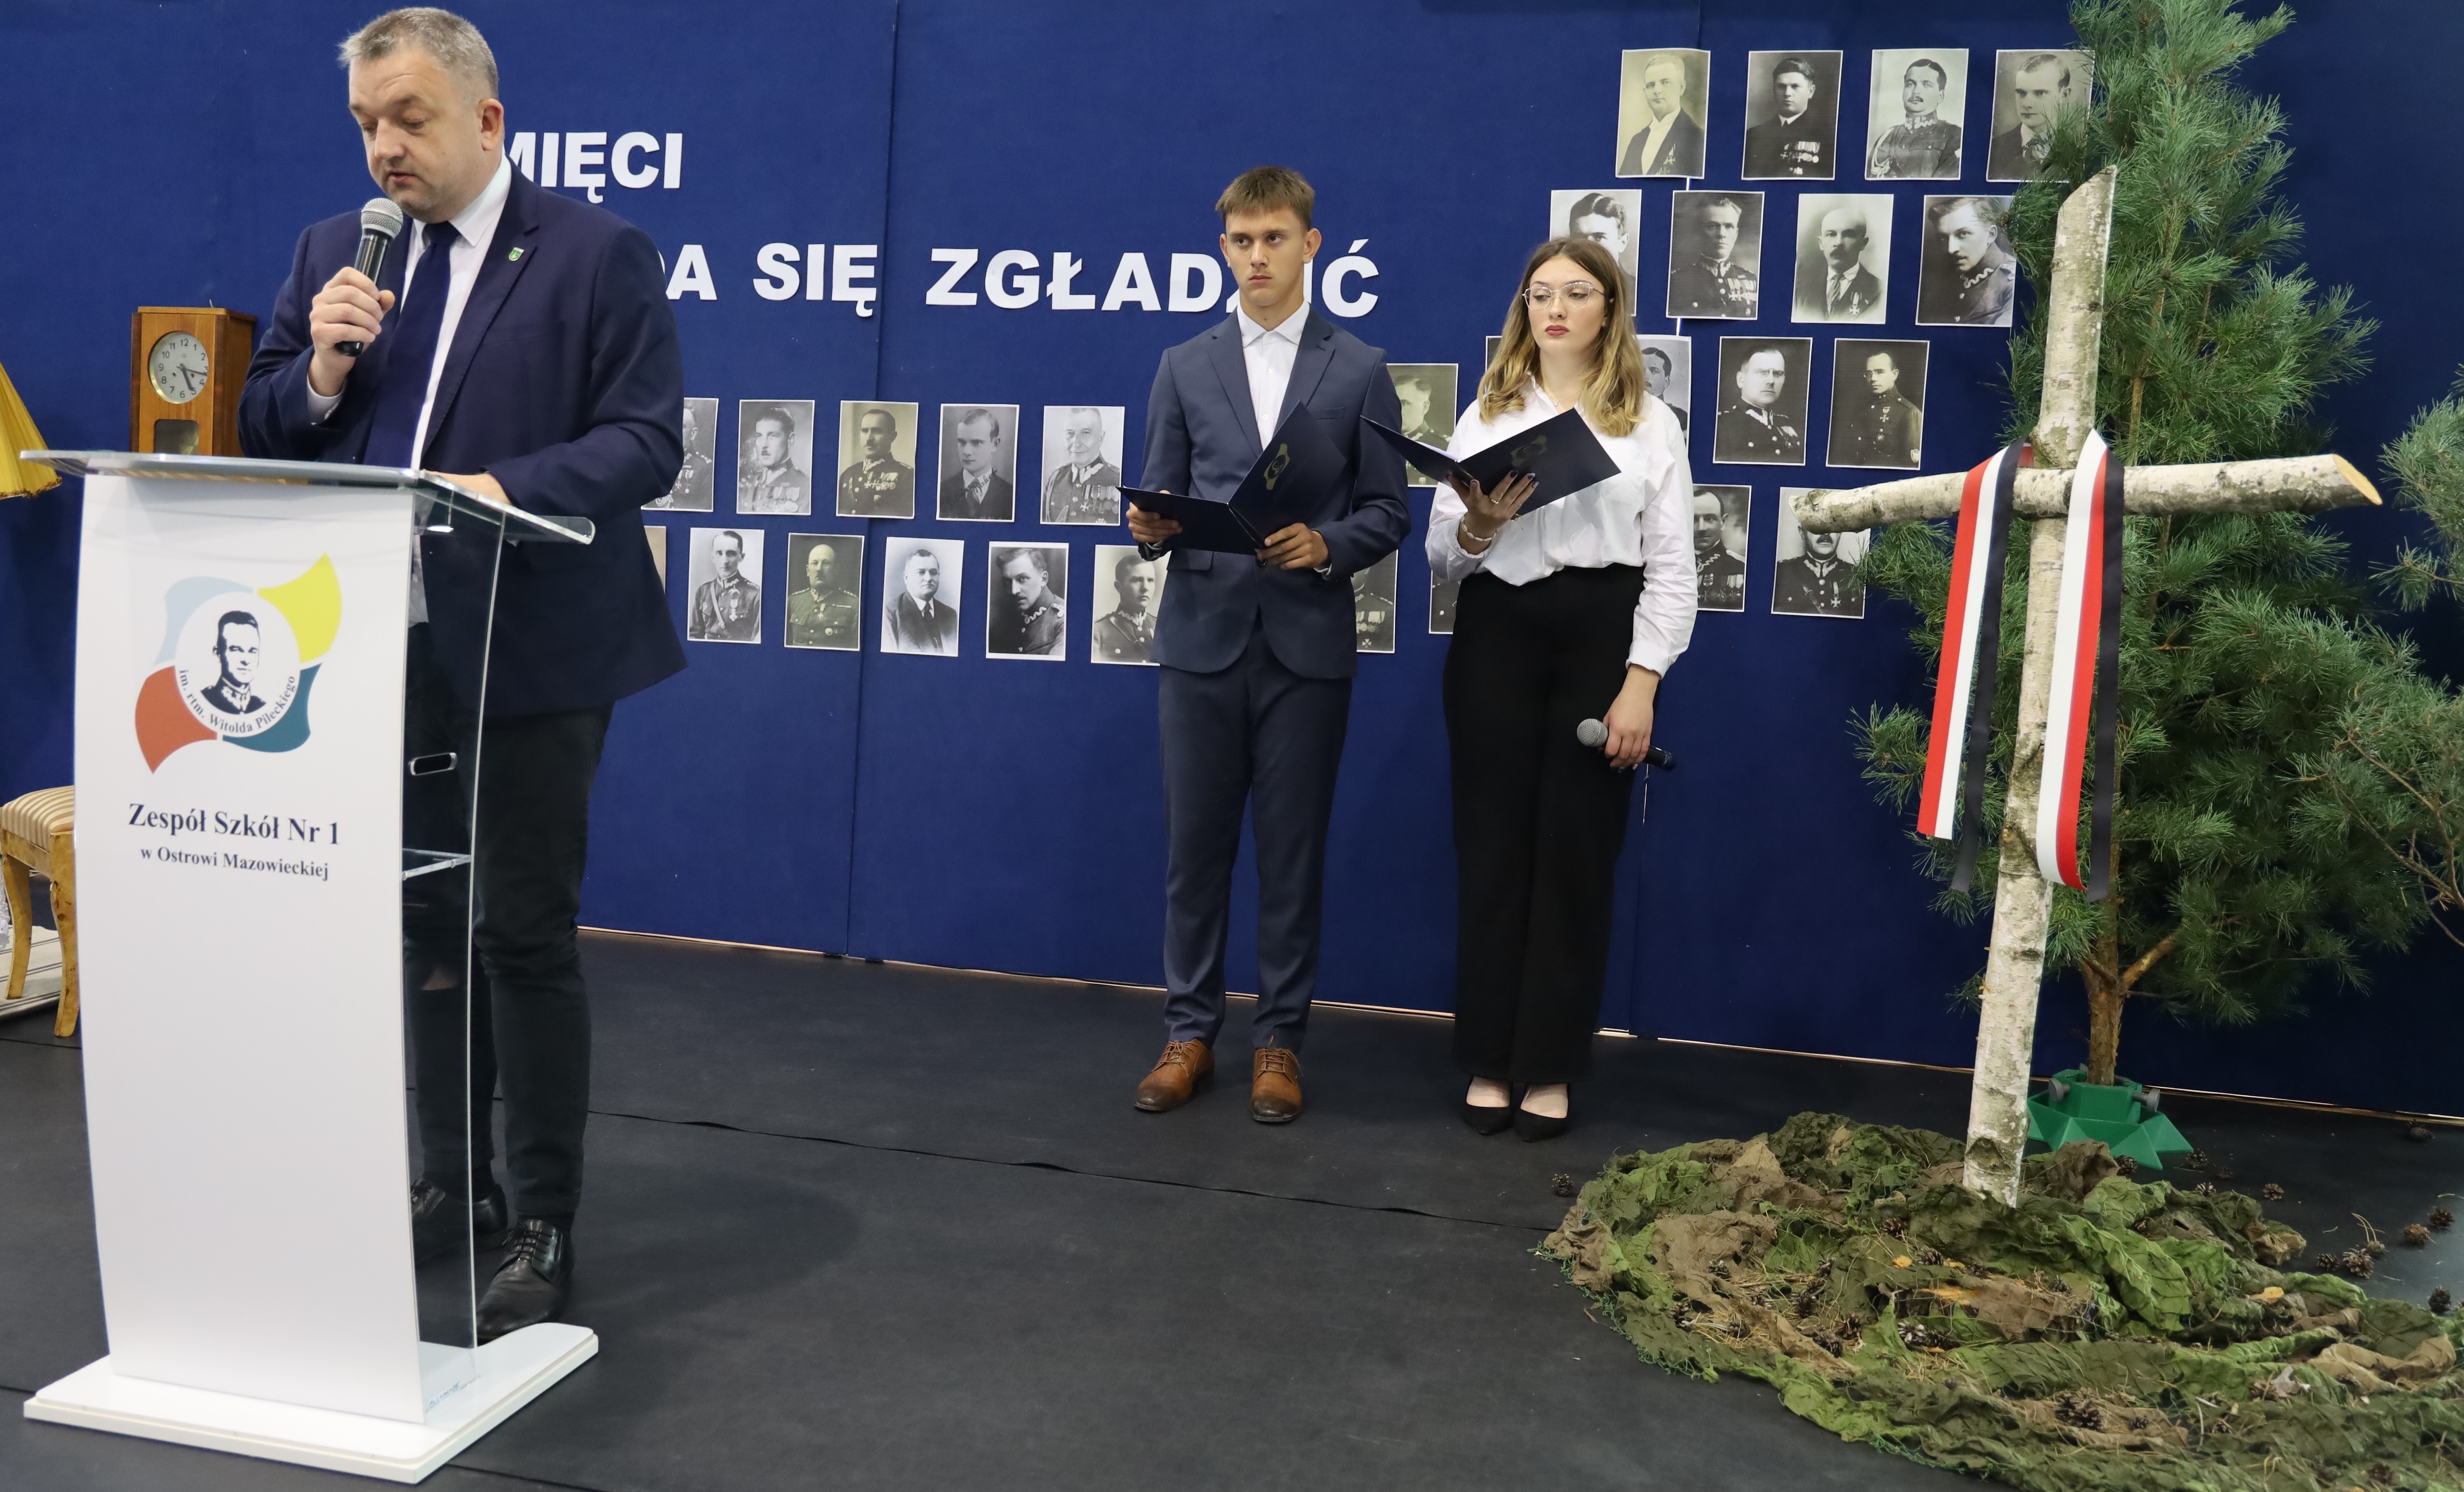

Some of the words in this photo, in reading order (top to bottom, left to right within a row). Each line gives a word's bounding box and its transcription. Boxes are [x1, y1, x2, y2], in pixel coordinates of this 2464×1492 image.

[657, 244, 717, 301] A
[753, 242, 878, 318] SIĘ
[925, 238, 1379, 318] ZGŁADĆ
[199, 379, 205, 387] 4
[179, 670, 189, 691] im.
[187, 693, 204, 718] rtm.
[209, 713, 253, 733] Witolda
[255, 676, 296, 729] Pileckiego
[129, 803, 207, 836] Zespół
[214, 811, 280, 839] Szkół
[287, 818, 321, 843] Nr
[329, 822, 339, 845] 1
[140, 848, 152, 860] w
[157, 846, 218, 867] Ostrowi
[223, 852, 328, 882] Mazowieckiej
